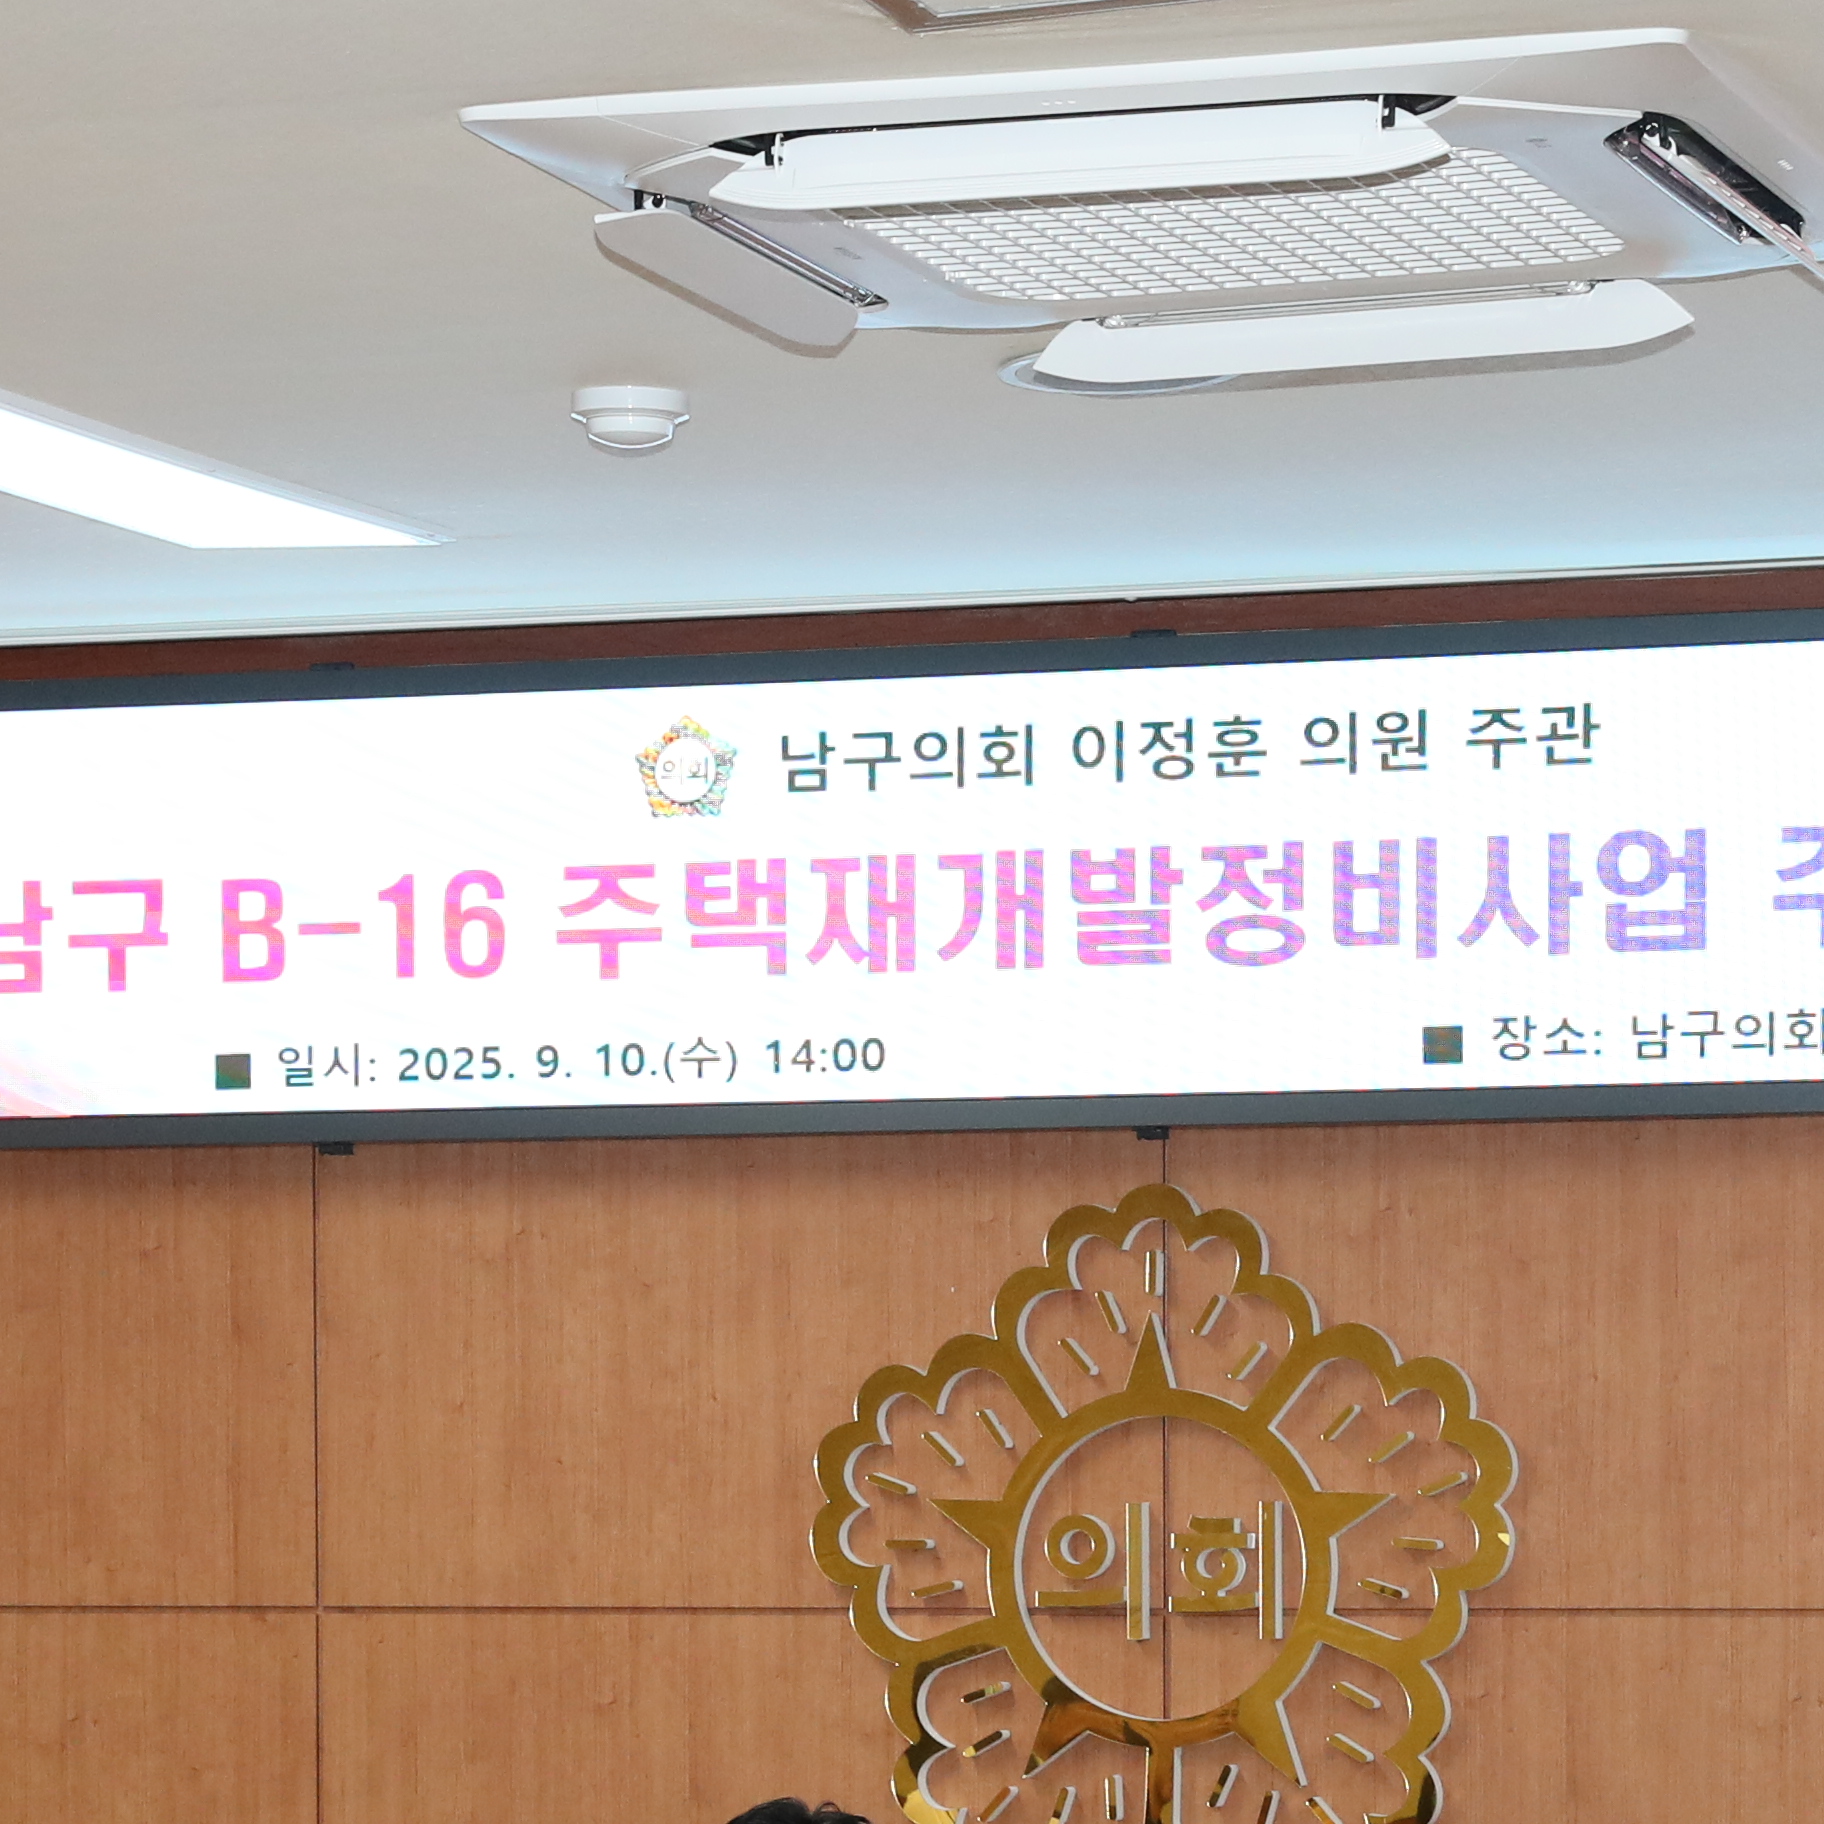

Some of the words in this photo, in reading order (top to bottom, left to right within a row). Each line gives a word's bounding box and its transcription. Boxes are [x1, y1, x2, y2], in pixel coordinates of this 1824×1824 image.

[781, 723, 1034, 793] 남구의회
[1072, 714, 1267, 783] 이정훈
[1300, 709, 1429, 775] 의원
[1466, 703, 1601, 770] 주관
[222, 870, 505, 982] B-16
[557, 829, 1707, 979] 주택재개발정비사업
[278, 1043, 378, 1087] 일시:
[399, 1046, 515, 1082] 2025.
[536, 1045, 571, 1078] 9.
[596, 1037, 737, 1083] 10.(수)
[766, 1038, 885, 1074] 14:00
[1493, 1015, 1602, 1061] 장소:
[1035, 1500, 1284, 1641] 의회
